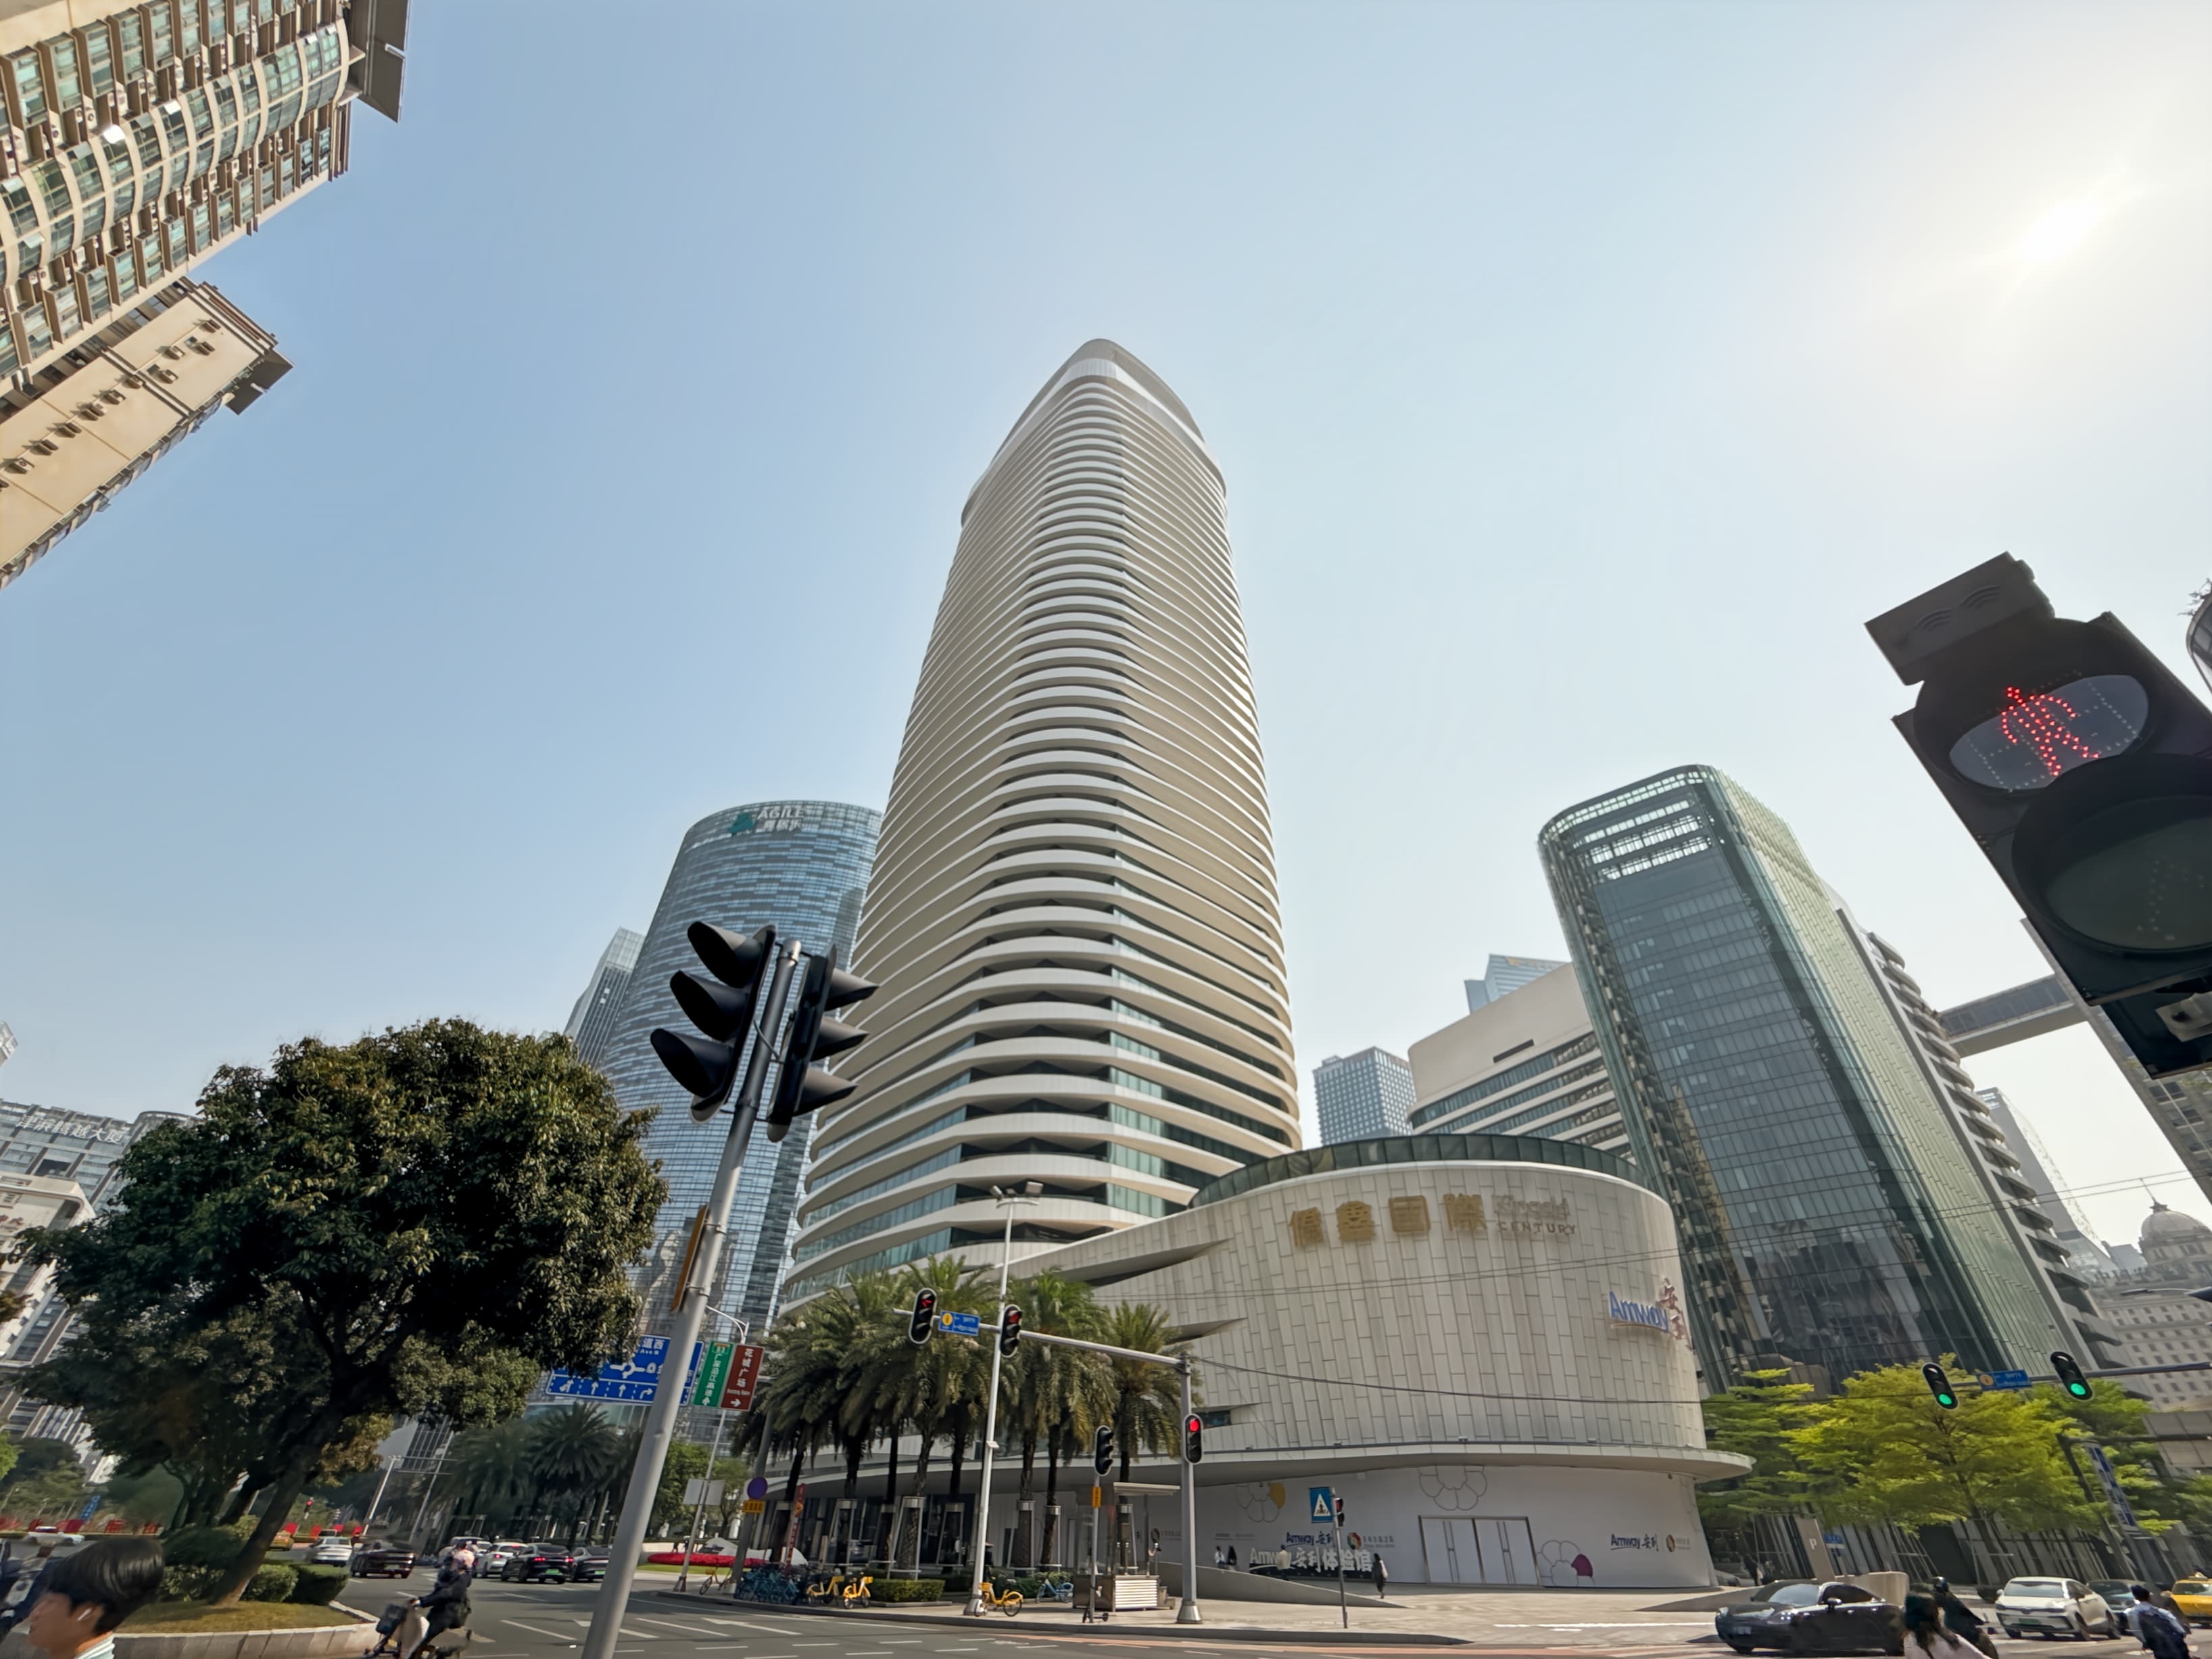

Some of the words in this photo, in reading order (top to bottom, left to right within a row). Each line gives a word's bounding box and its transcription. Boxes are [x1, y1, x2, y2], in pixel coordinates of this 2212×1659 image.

[757, 807, 805, 819] AGILE
[1497, 1221, 1576, 1235] CENTURY
[1609, 1291, 1668, 1333] Amway
[736, 1348, 754, 1388] 花城广场
[1287, 1532, 1314, 1545] Amway
[1611, 1533, 1641, 1549] Amway
[1250, 1547, 1292, 1568] Amwy
